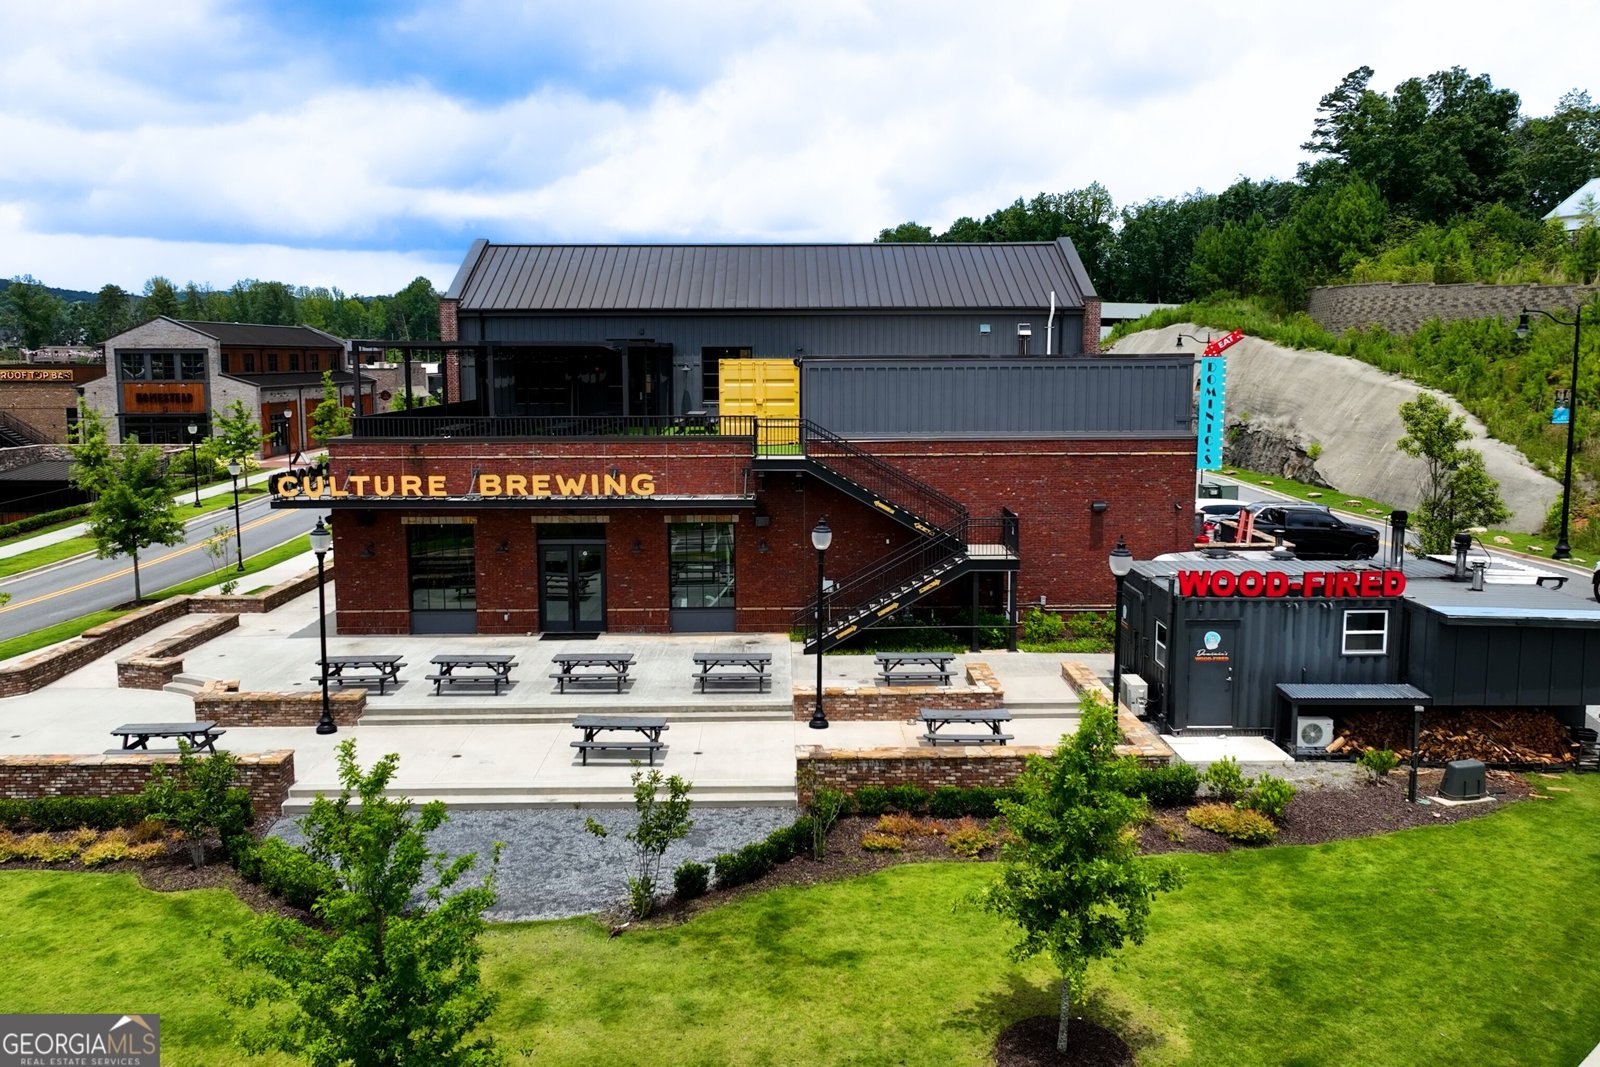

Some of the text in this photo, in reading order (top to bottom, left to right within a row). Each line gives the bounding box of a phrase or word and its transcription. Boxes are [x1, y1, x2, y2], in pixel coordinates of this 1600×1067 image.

[1217, 334, 1234, 349] EAT
[136, 392, 194, 403] HOMESTEAD
[277, 473, 656, 497] CULTURE BREWING
[1178, 569, 1406, 598] WOOD-FIRED
